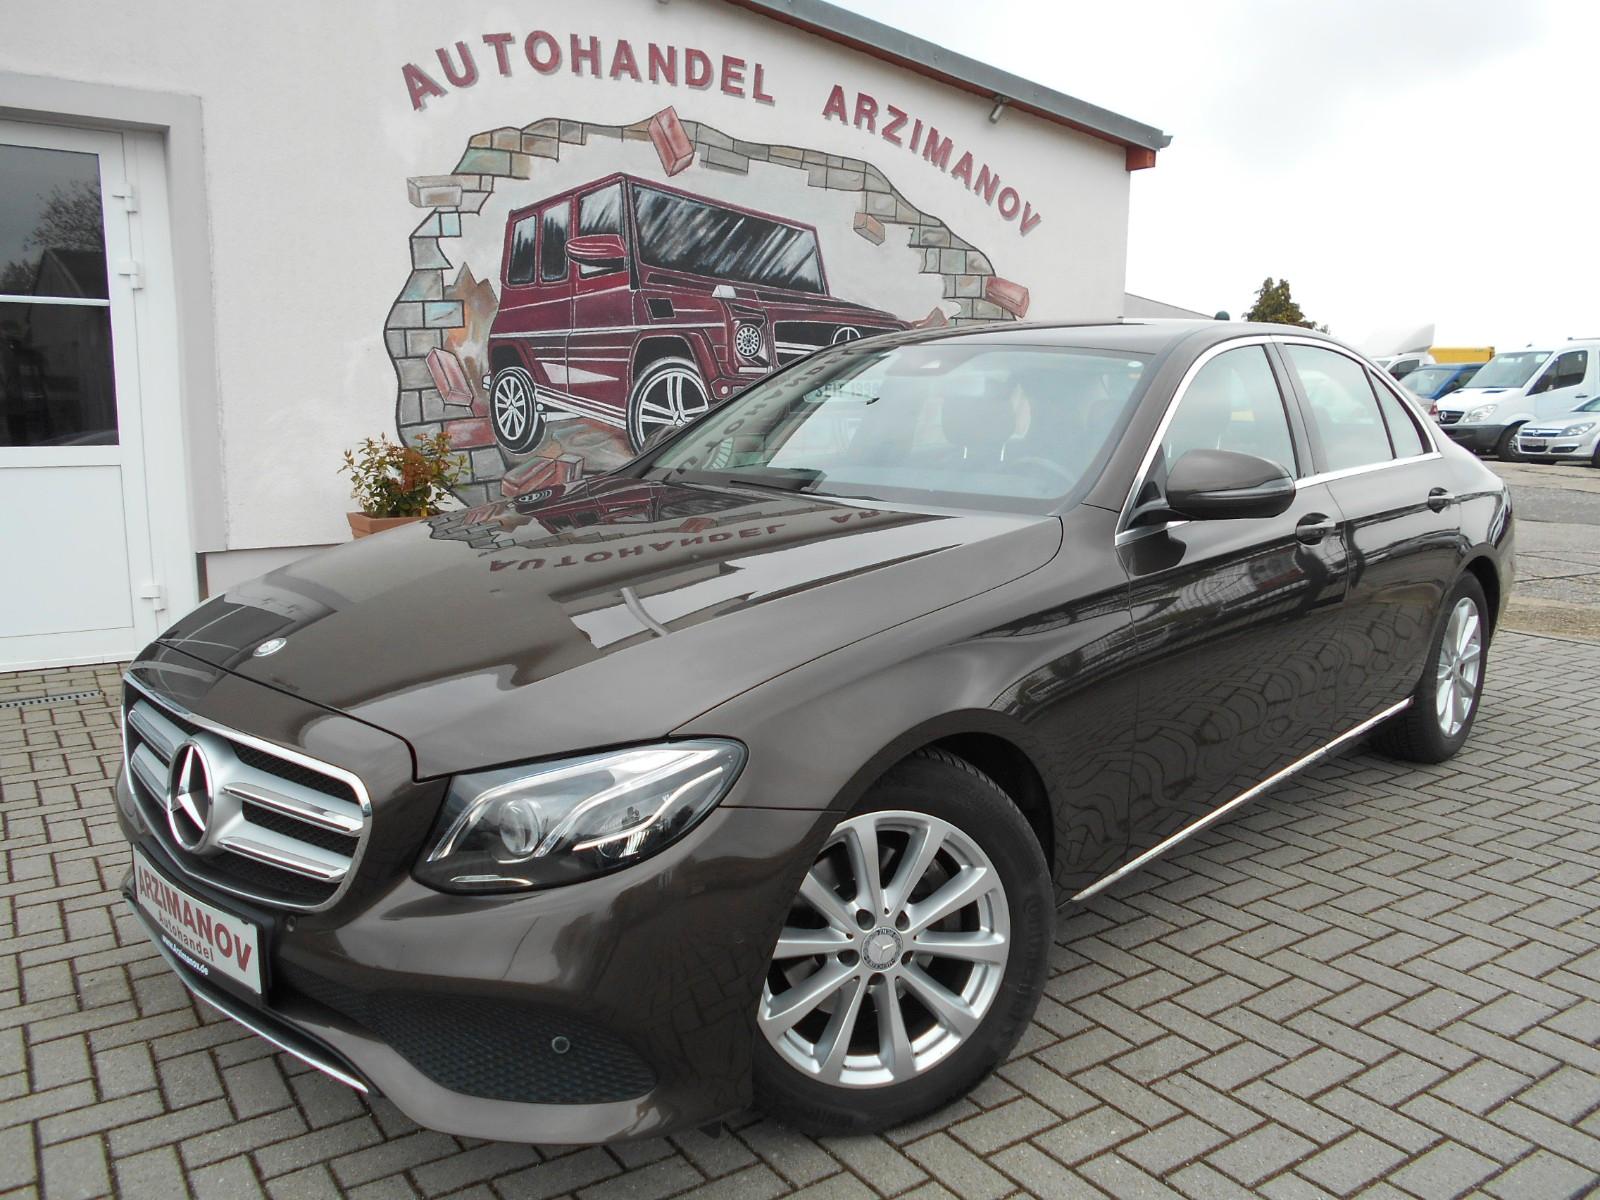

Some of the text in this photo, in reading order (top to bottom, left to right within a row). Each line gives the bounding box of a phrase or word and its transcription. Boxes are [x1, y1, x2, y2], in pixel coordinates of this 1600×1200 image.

[400, 30, 1042, 236] AUTOHANDEL ARZIMANOV
[138, 864, 253, 973] ARZIMANOV
[158, 909, 215, 962] Autohandel
